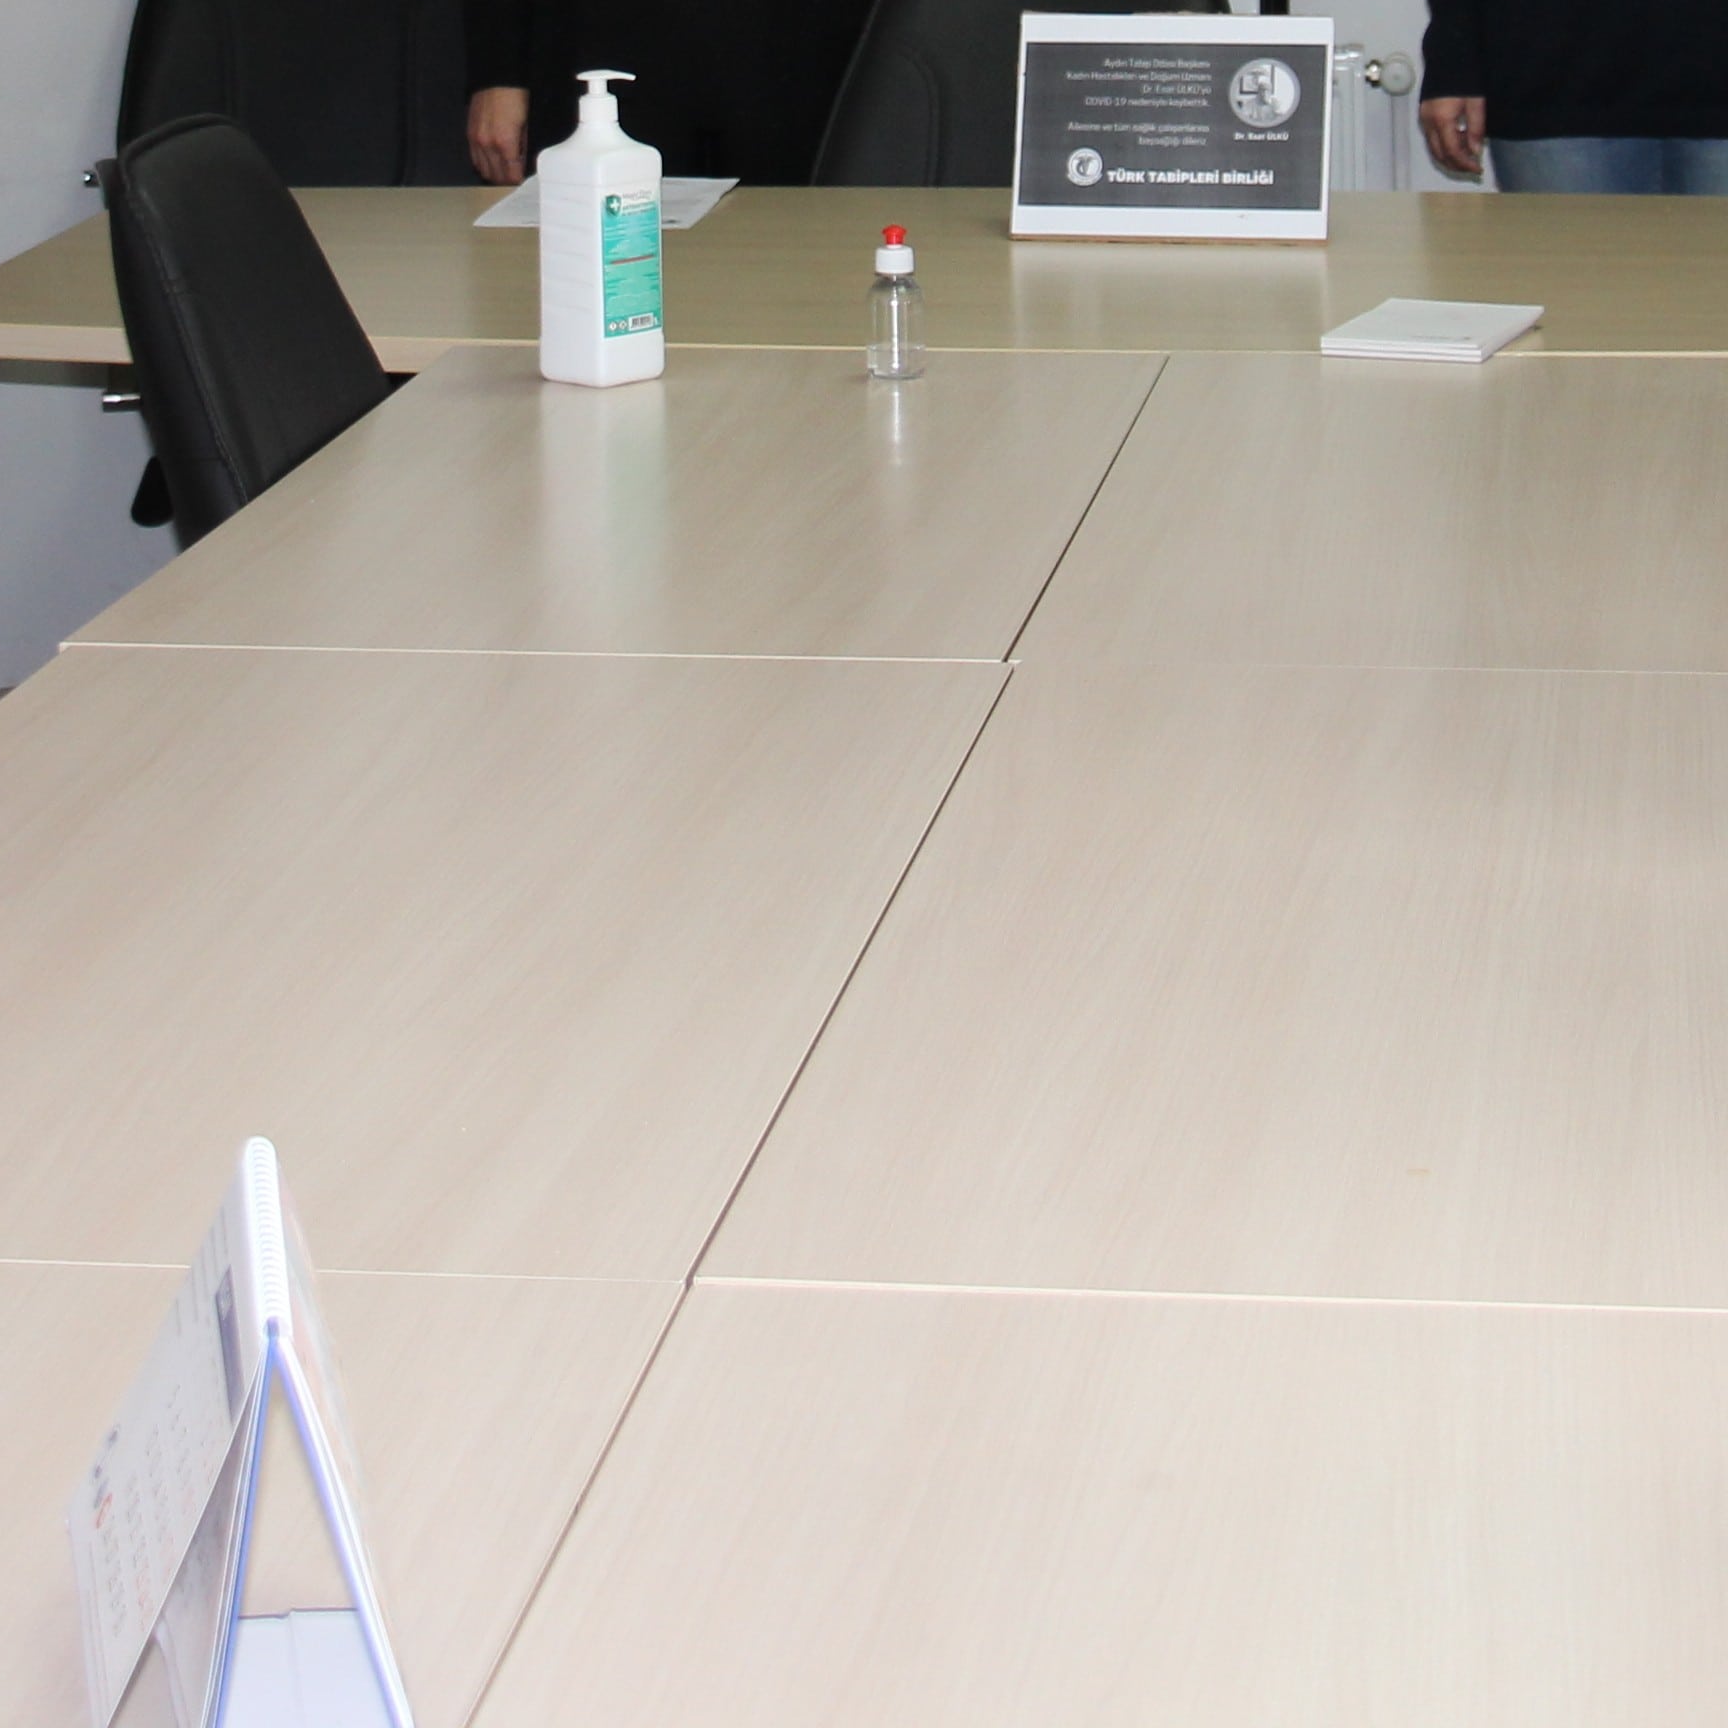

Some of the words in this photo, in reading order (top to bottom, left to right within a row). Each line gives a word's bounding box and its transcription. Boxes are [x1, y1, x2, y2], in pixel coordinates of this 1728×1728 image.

[1106, 168, 1145, 184] TÜRK
[1147, 169, 1219, 184] TABİPLERİ
[1221, 170, 1274, 185] BİRLİĞİ
